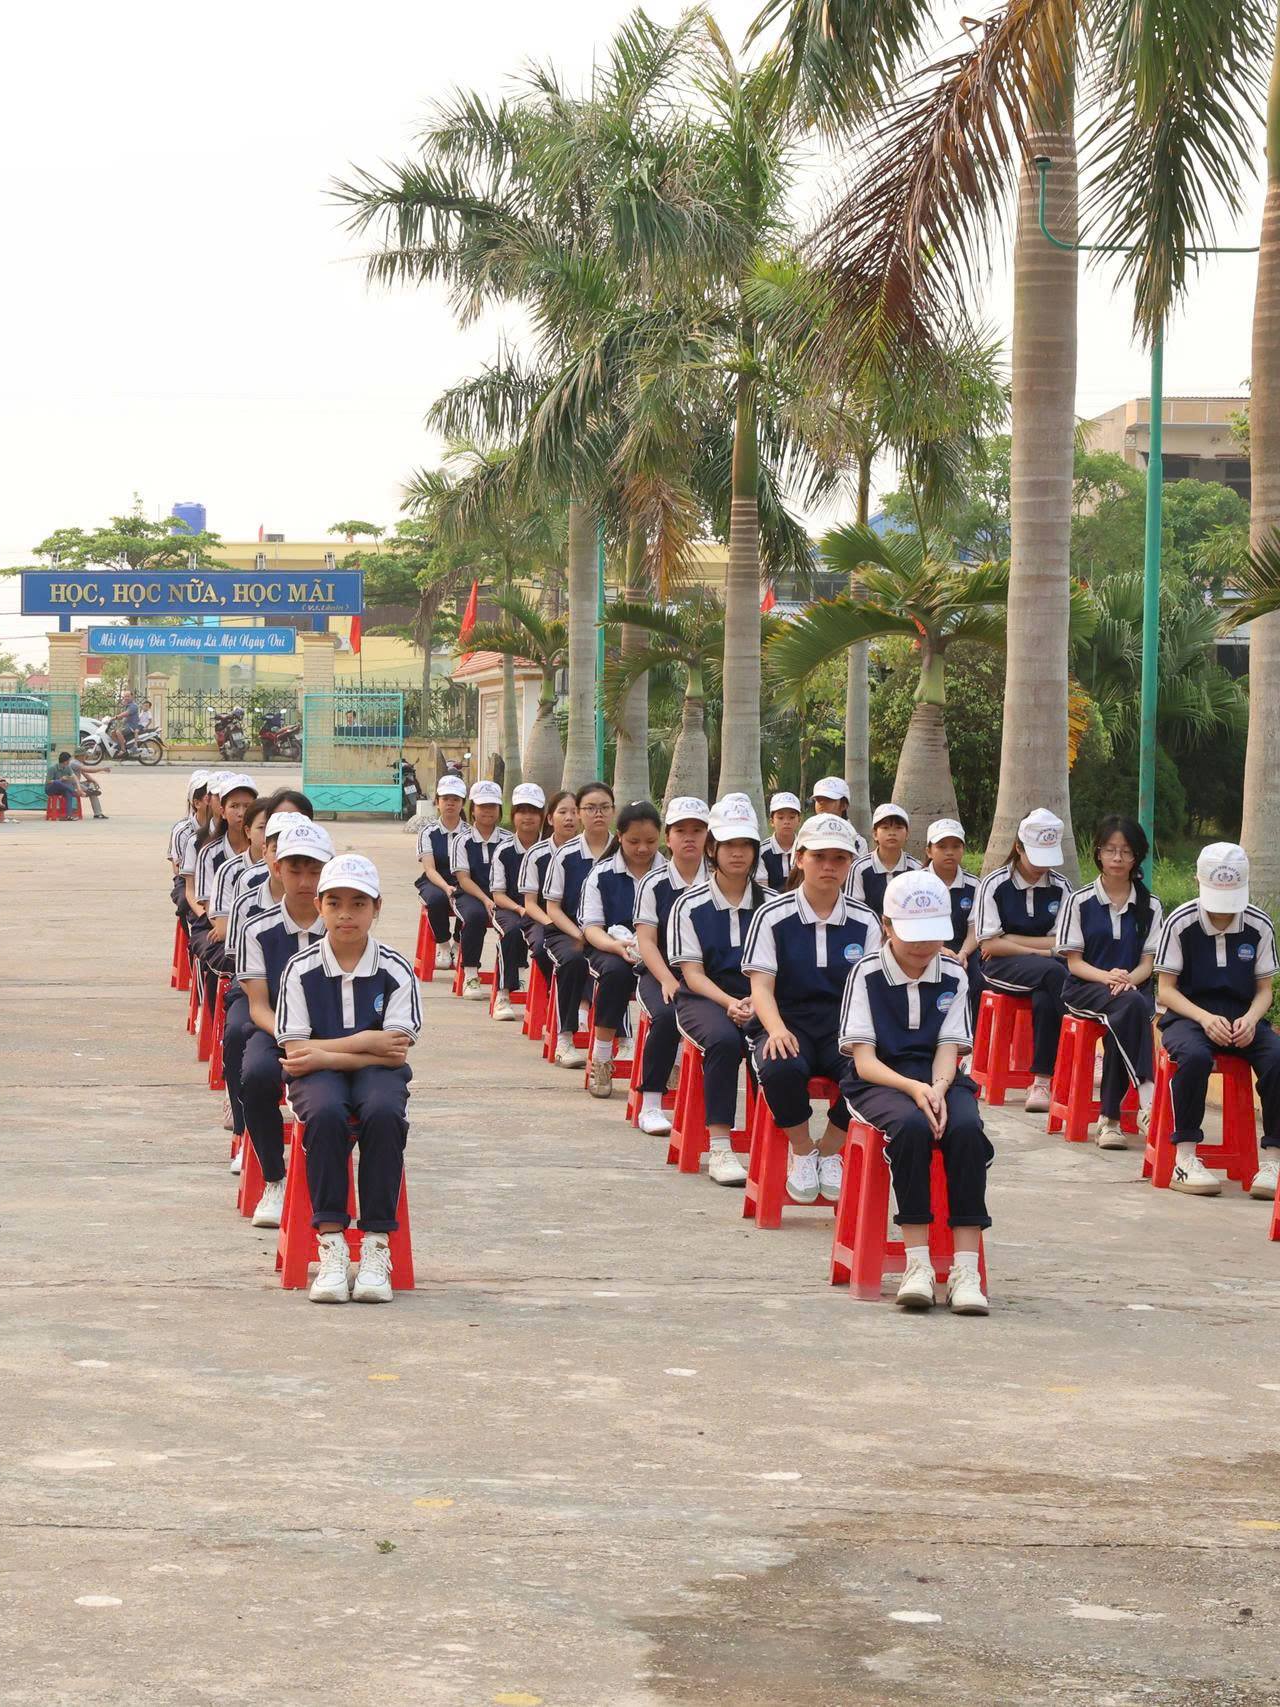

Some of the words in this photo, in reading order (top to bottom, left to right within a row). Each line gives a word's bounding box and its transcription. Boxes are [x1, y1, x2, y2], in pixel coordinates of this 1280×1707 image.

[49, 583, 105, 608] HỌC,
[112, 583, 161, 608] HỌC
[168, 578, 226, 606] NỮA,
[232, 583, 282, 608] HỌC
[287, 578, 336, 603] MÃI
[98, 632, 117, 647] Mỗi
[119, 632, 145, 649] Ngày
[147, 632, 166, 647] Đến
[169, 633, 202, 650] Trường
[204, 633, 217, 648] Là
[219, 633, 237, 649] Một
[239, 633, 265, 650] Ngày
[267, 633, 286, 648] Vui
